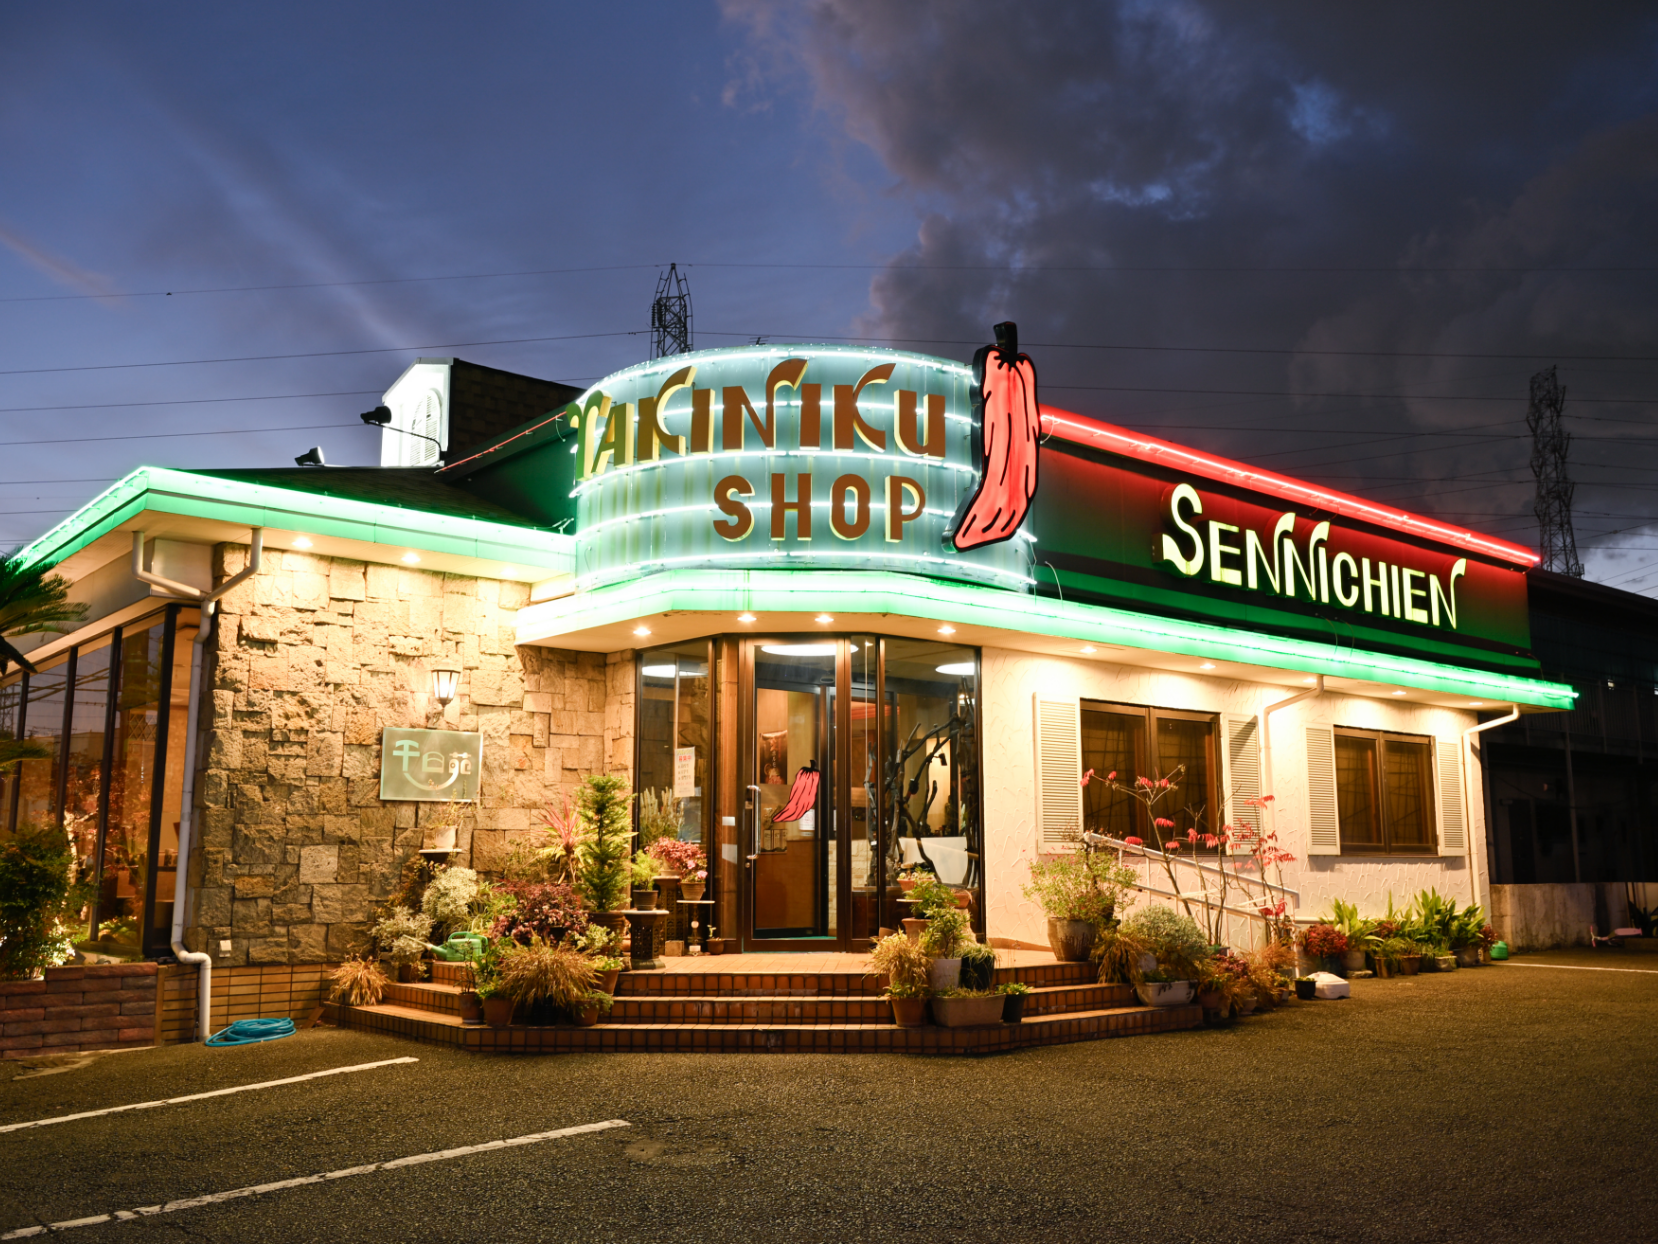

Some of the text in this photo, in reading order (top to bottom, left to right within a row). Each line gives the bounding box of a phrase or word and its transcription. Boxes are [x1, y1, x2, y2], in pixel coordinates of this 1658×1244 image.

[566, 358, 946, 481] YAKINIKU
[713, 473, 926, 542] SHOP
[1162, 483, 1467, 630] SENNICHIEN
